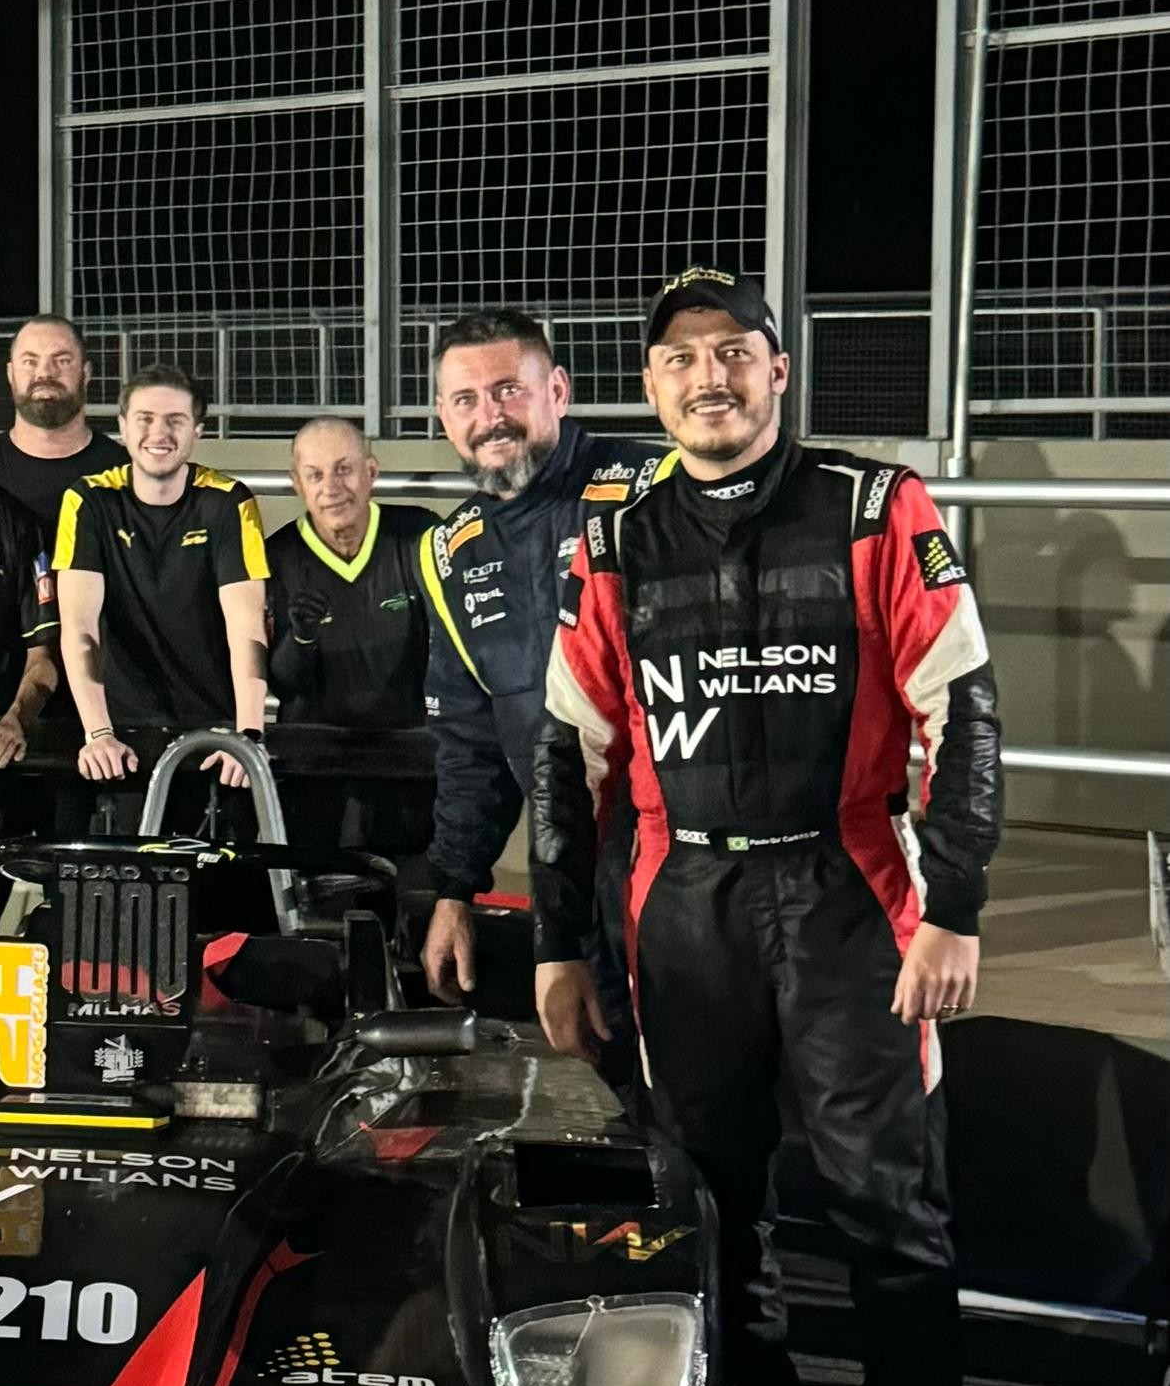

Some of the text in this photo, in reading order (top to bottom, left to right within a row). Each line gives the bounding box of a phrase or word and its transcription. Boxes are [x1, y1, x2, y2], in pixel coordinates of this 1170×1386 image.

[698, 645, 837, 671] NELSON
[698, 673, 837, 699] WLIANS
[58, 863, 191, 882] ROAD TO
[58, 880, 190, 1007] 1000
[67, 1002, 182, 1018] MILHAS
[9, 1147, 236, 1173] NELSON
[7, 1165, 237, 1191] WILIANS
